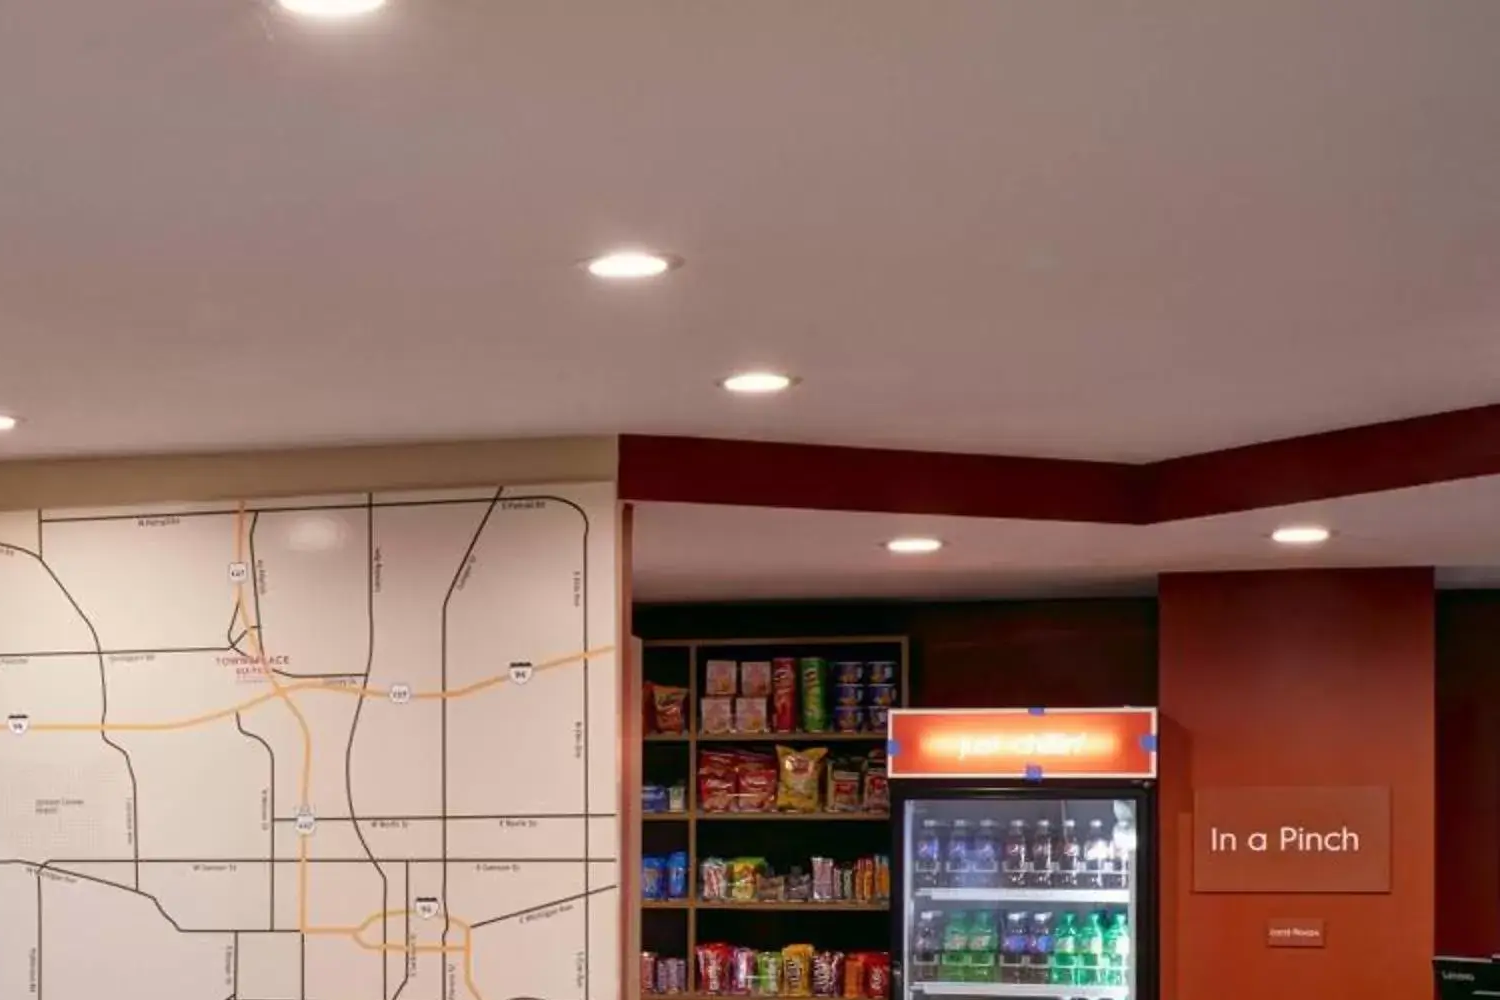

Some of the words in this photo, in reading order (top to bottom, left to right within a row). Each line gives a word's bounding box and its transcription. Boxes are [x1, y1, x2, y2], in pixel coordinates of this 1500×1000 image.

[1211, 827, 1237, 851] In
[1248, 833, 1268, 851] a
[1280, 827, 1359, 851] Pinch
